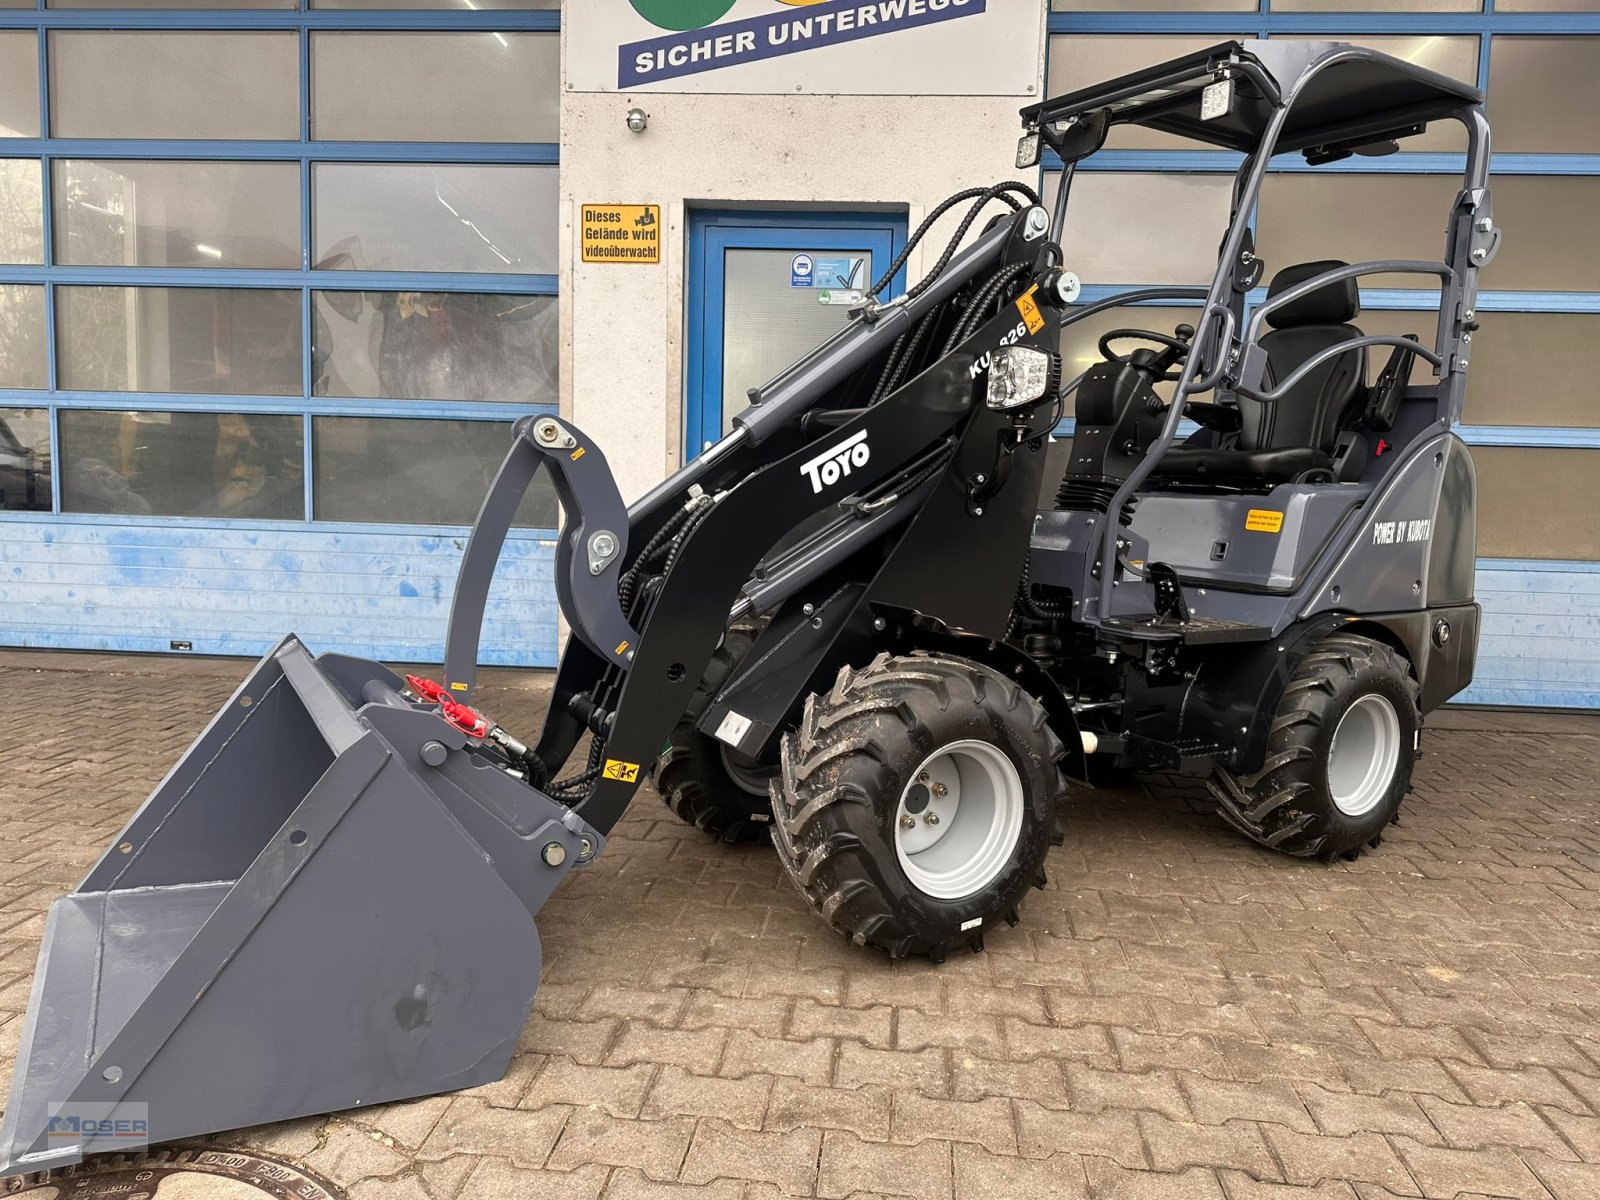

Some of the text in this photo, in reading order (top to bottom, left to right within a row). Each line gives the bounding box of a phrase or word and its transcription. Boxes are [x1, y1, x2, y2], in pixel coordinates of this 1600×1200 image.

[634, 31, 756, 74] SICHER
[585, 210, 621, 223] Dieses
[585, 227, 656, 241] Gelände wird
[585, 244, 657, 258] videoüberwacht
[968, 350, 991, 380] KU
[799, 428, 870, 494] TOYO
[1372, 519, 1431, 545] POWER BY KUBOTA
